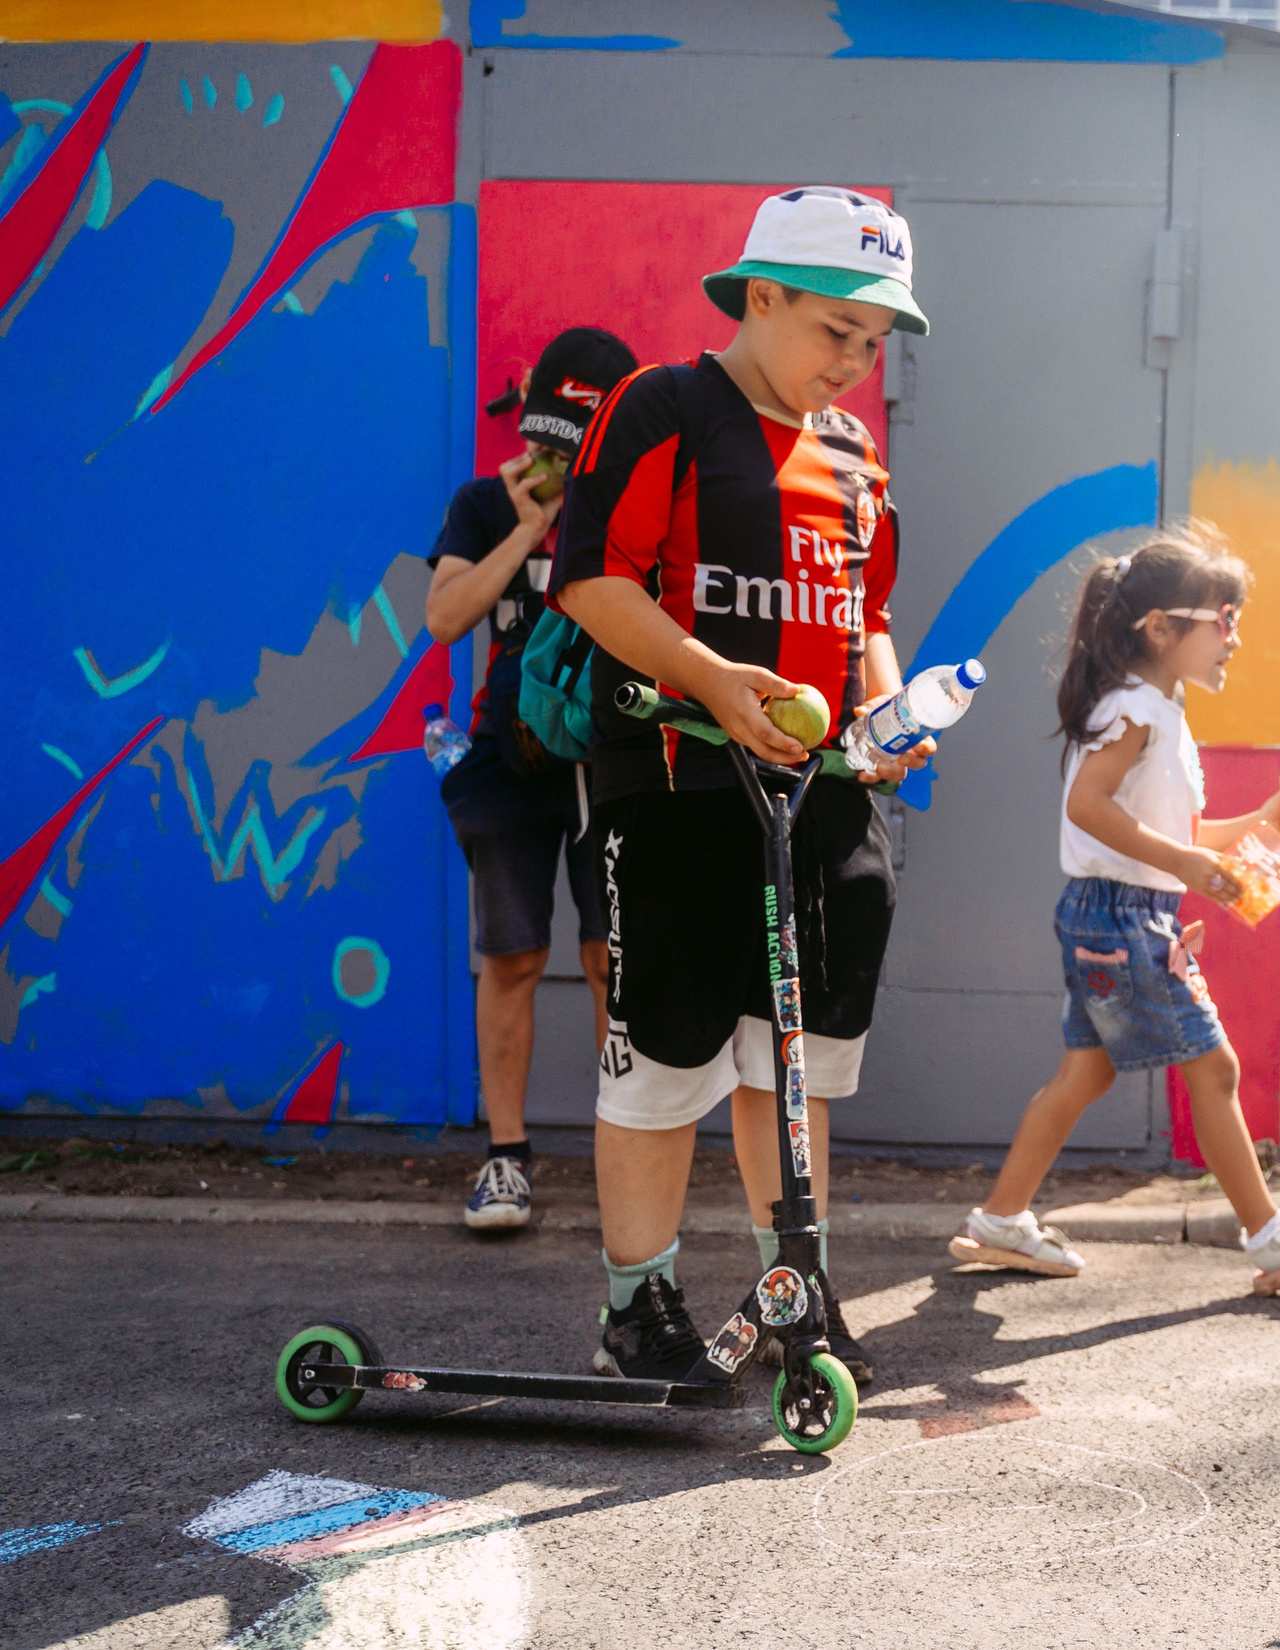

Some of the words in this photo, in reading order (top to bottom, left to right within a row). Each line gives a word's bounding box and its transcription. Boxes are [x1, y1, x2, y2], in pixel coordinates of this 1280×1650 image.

[861, 226, 906, 261] FILA
[788, 525, 844, 577] Fly
[764, 884, 779, 928] RUSH
[767, 931, 782, 986] ACTION
